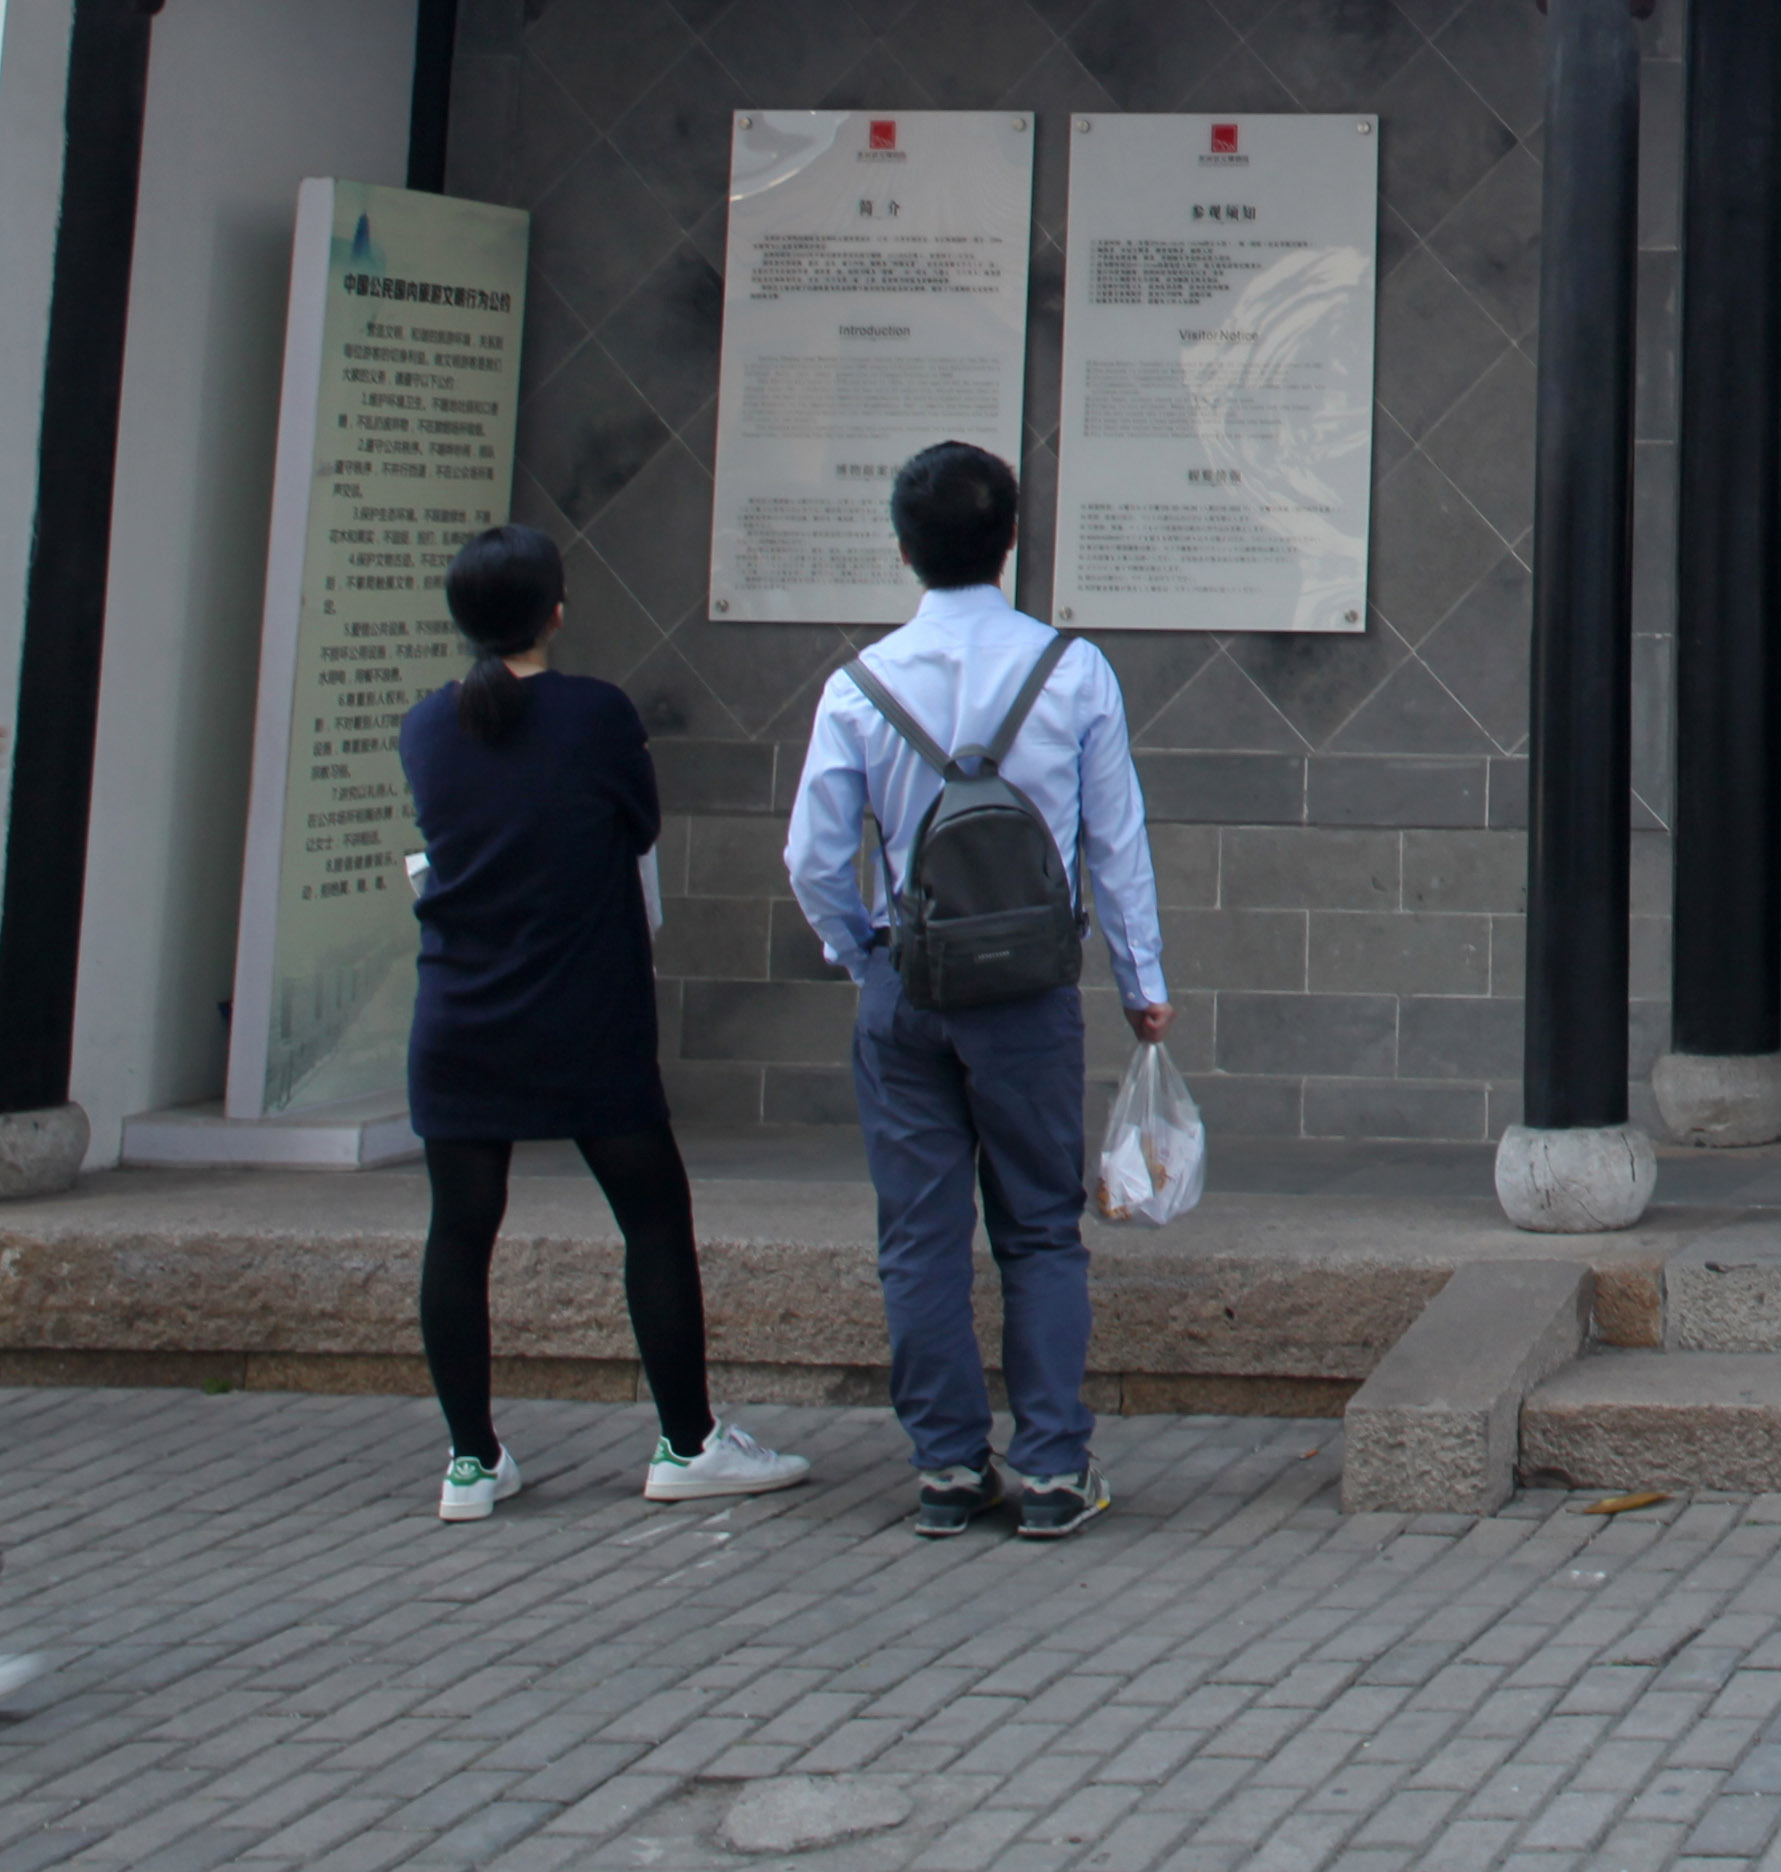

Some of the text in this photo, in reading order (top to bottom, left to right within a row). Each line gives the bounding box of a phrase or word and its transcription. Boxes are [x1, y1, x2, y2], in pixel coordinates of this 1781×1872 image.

[1192, 203, 1256, 220] 参观须知
[344, 273, 511, 313] 中国公民国内旅游文明行为公约
[839, 325, 911, 336] Introduction
[1179, 329, 1258, 341] Visitor Notice
